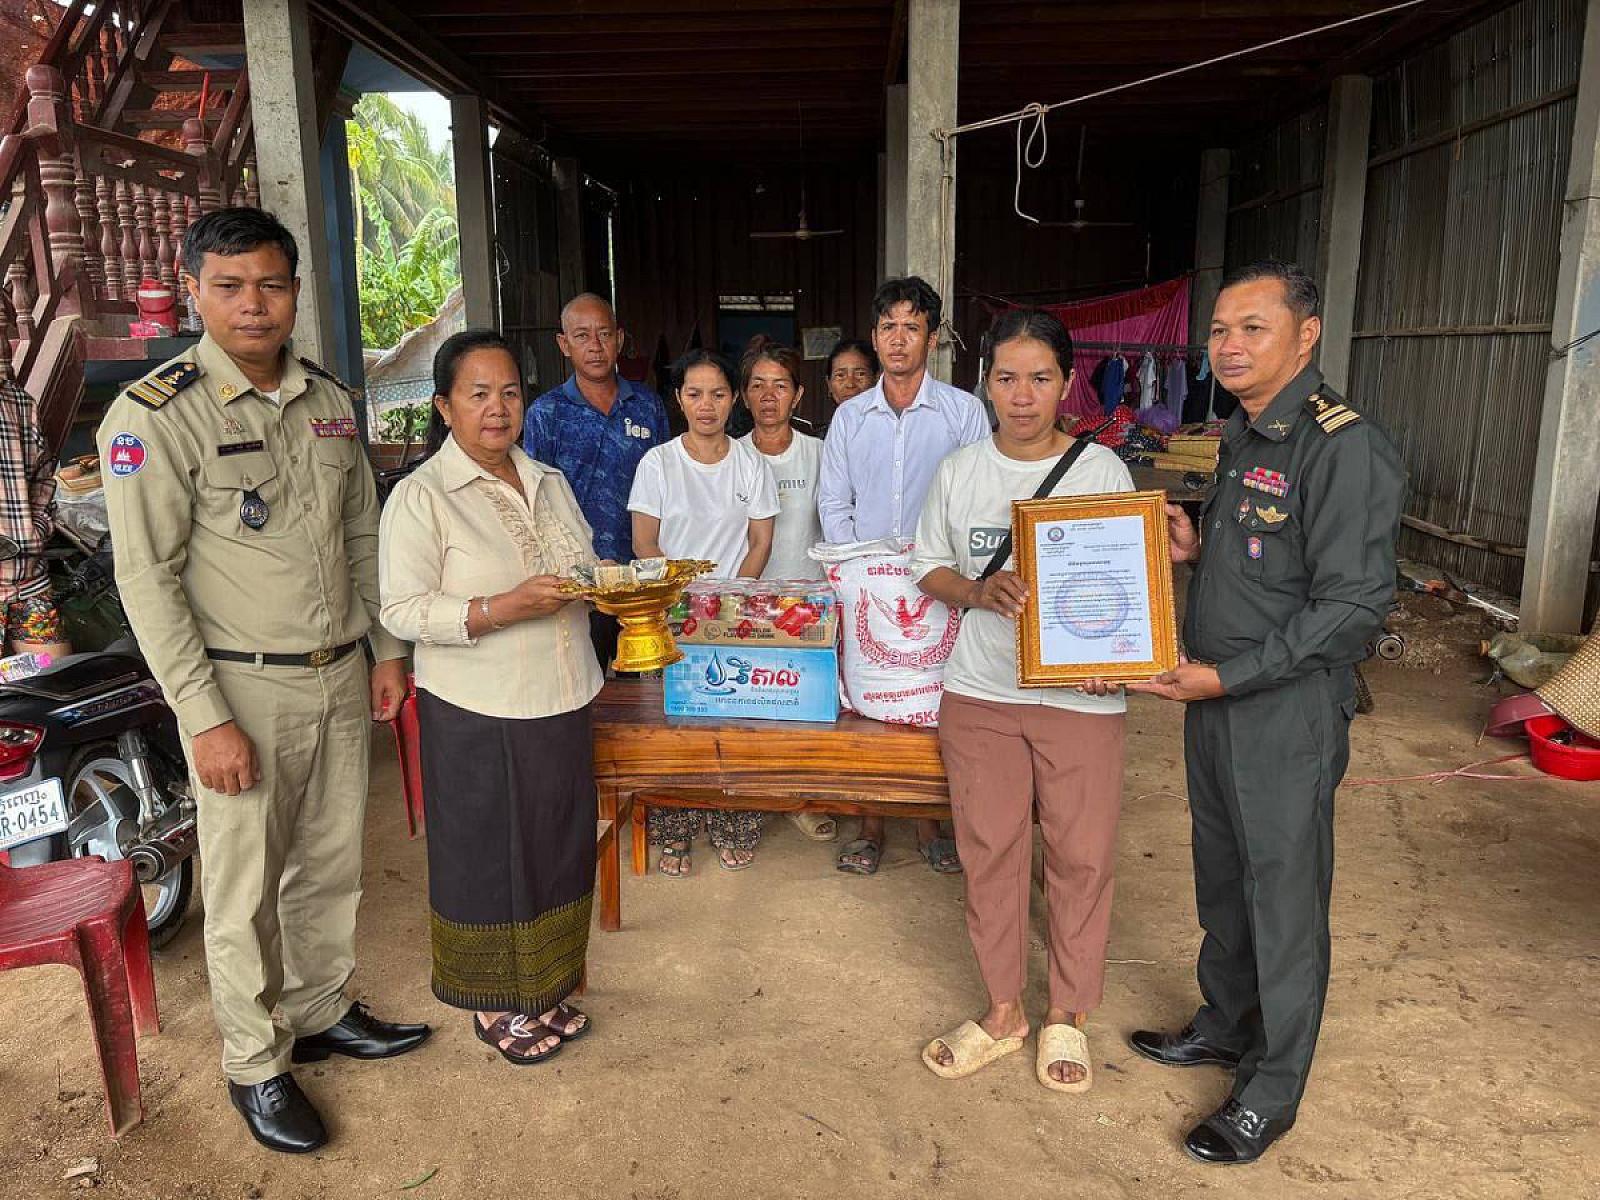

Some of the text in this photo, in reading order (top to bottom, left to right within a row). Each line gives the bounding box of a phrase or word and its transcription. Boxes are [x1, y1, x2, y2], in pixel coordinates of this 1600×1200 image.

[970, 531, 1007, 549] Su
[727, 656, 800, 686] វីតាល់
[0, 801, 60, 837] R-0454
